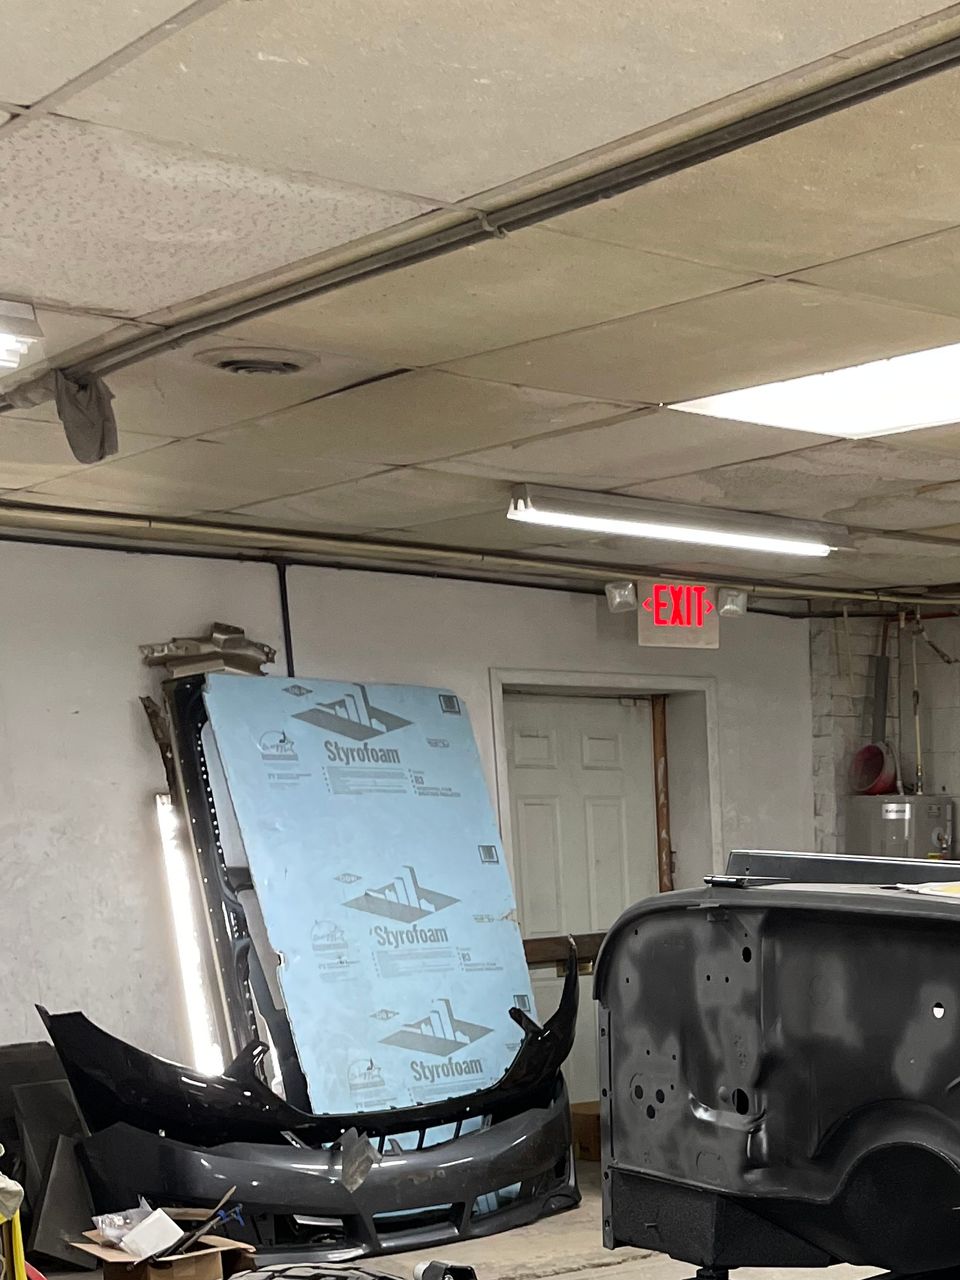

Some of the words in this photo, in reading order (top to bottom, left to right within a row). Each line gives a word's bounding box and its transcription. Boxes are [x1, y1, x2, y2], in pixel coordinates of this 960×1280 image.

[653, 583, 708, 627] EXIT
[324, 739, 401, 766] Styrofoam
[372, 923, 449, 949] Styrofoam
[410, 1056, 484, 1083] Styrofoam
